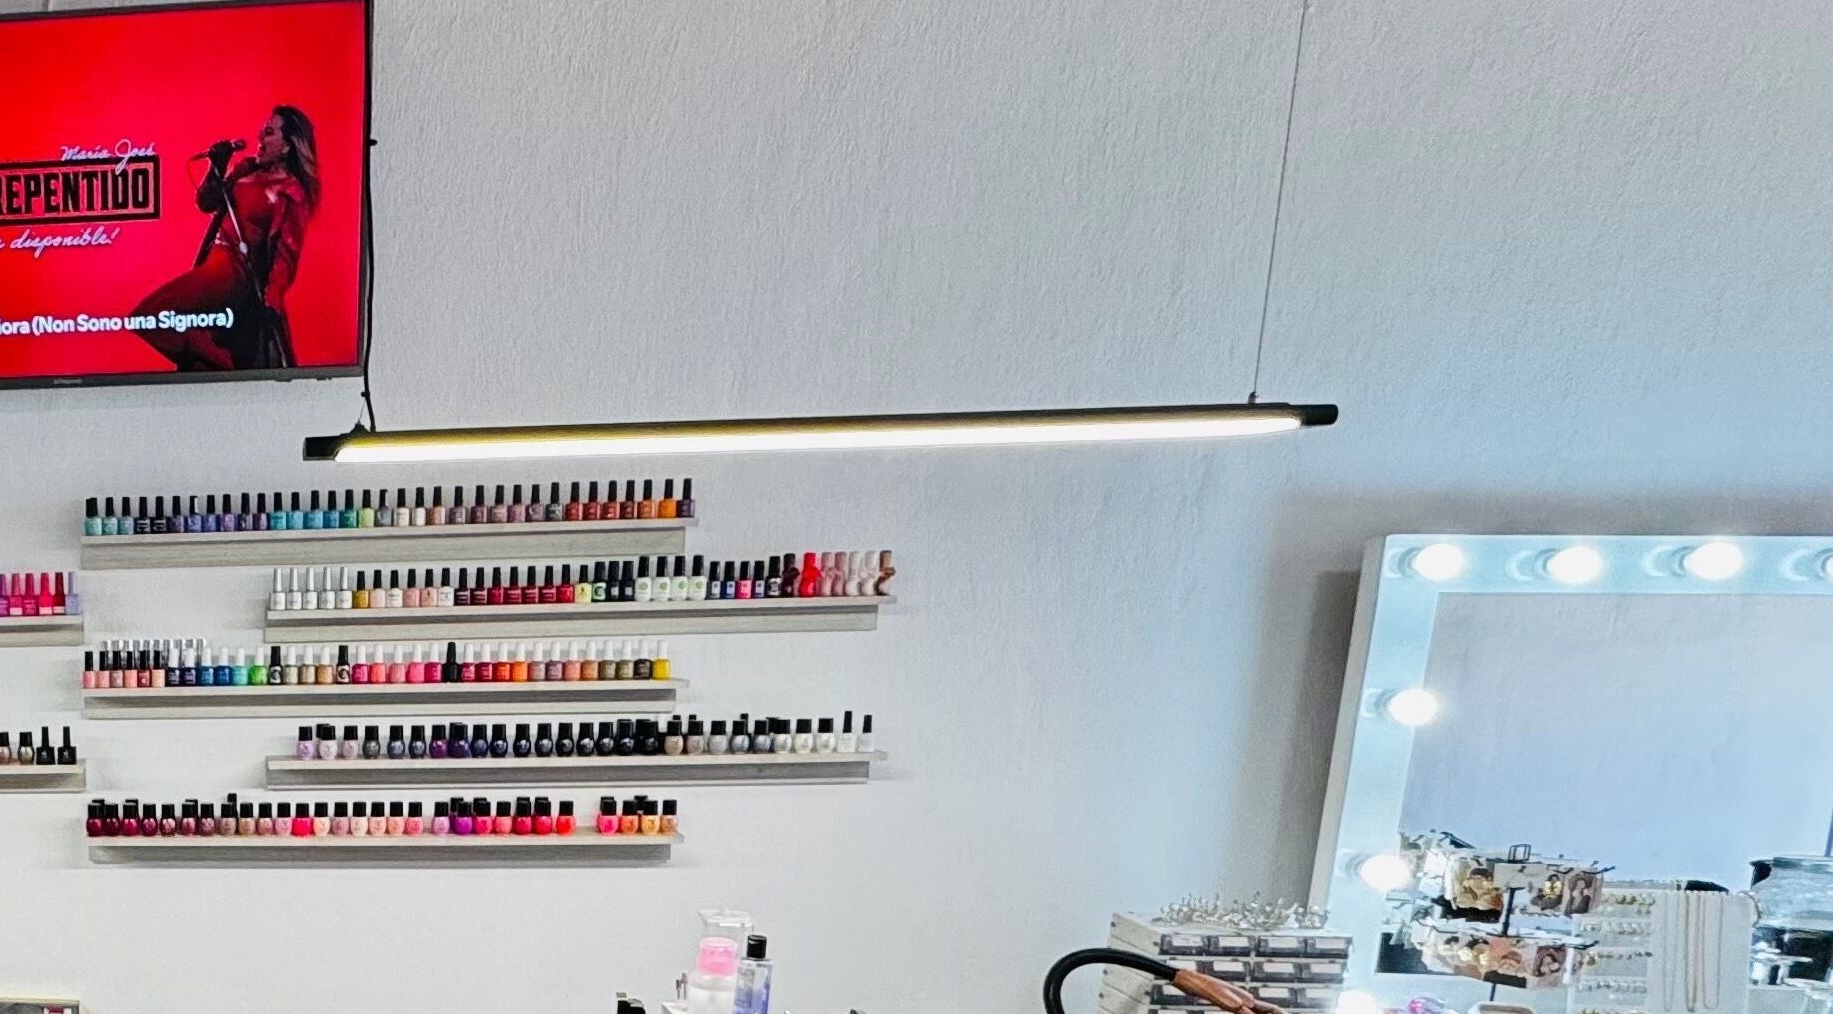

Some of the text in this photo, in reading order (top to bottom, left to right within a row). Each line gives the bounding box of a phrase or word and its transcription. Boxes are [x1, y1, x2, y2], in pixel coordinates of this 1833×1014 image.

[10, 226, 121, 258] disponible!
[32, 315, 76, 336] (Non
[76, 313, 123, 332] Sono
[124, 315, 157, 331] una
[158, 307, 235, 332] Signora)
